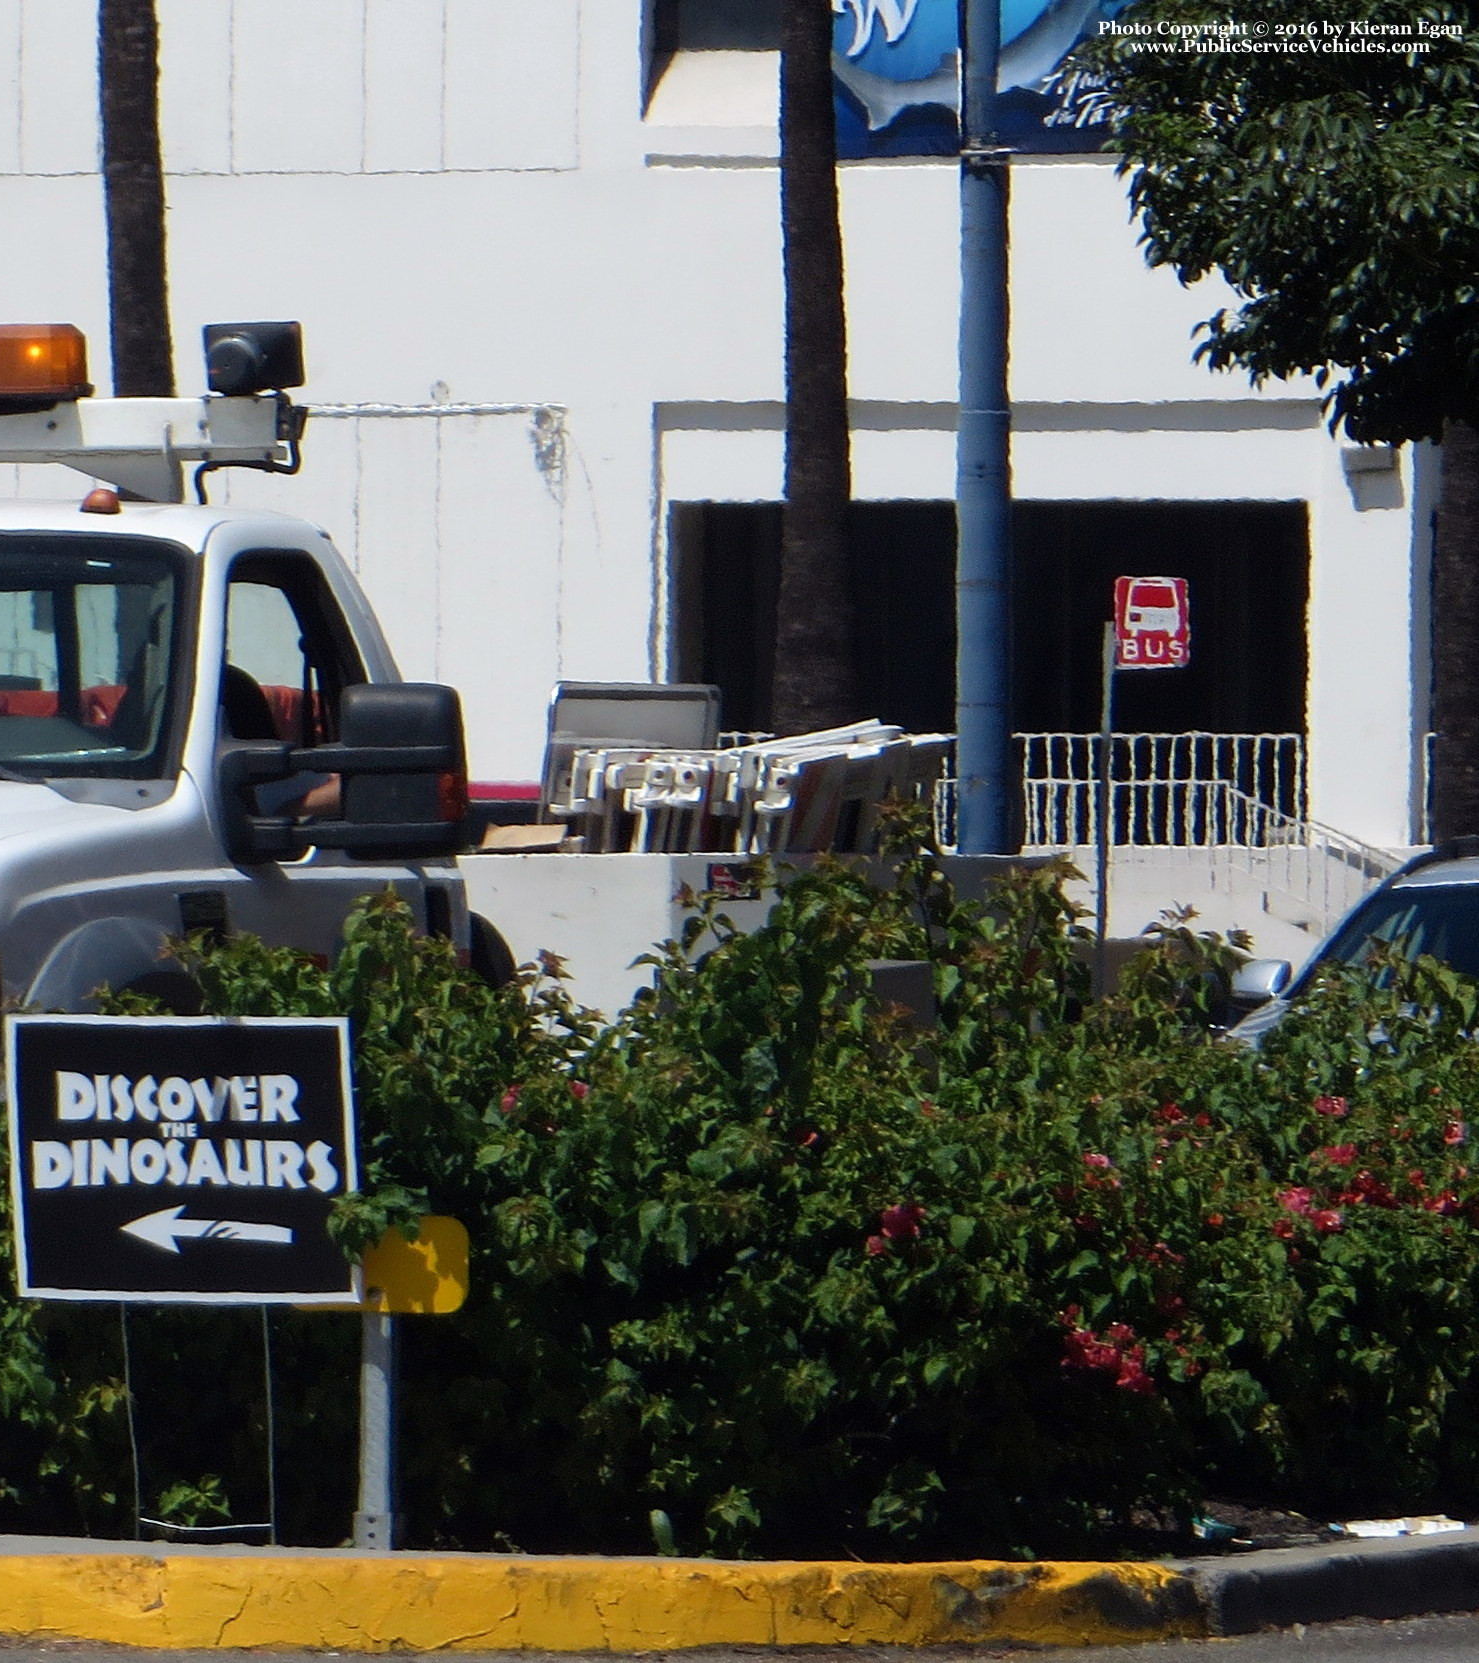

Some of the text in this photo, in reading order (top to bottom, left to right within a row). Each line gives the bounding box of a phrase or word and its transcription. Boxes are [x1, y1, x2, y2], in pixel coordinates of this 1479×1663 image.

[1122, 637, 1184, 660] BUS
[55, 1070, 300, 1124] DISCOVER
[159, 1121, 198, 1138] THE
[31, 1137, 339, 1193] DINOSAURS
